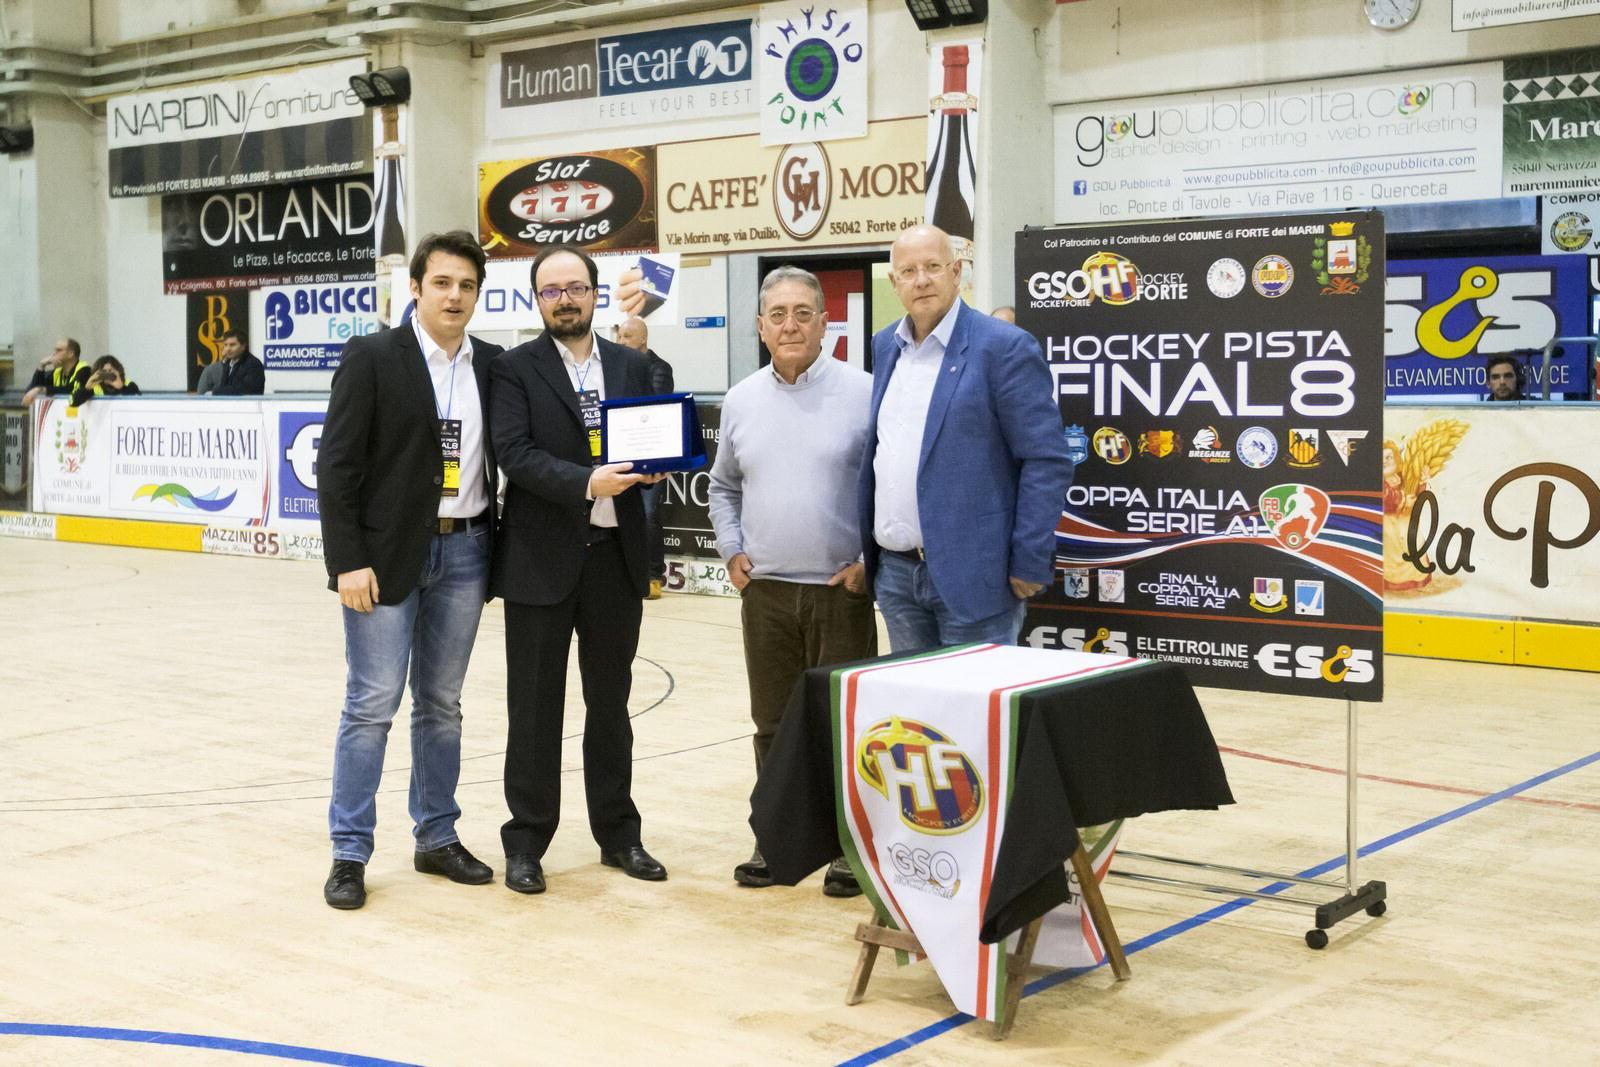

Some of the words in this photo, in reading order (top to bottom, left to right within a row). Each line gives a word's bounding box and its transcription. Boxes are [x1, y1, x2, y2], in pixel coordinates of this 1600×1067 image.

[764, 5, 863, 63] PHYSIO
[507, 63, 592, 100] Human
[601, 41, 683, 87] Tecar
[114, 90, 246, 139] NARDINI
[600, 102, 637, 118] FEEL
[650, 94, 695, 112] YOUR
[710, 88, 752, 107] BEST
[766, 92, 845, 131] POINT
[1162, 133, 1222, 155] design
[1241, 125, 1307, 152] printing
[1327, 121, 1372, 142] web
[1377, 114, 1478, 138] marketing
[535, 159, 591, 183] Slot
[1184, 167, 1318, 186] www.goupubblicita.com
[1327, 154, 1476, 176] info@goupubblicita.com
[165, 179, 188, 191] FORTE
[190, 177, 201, 189] DEI
[202, 175, 227, 188] MARMI
[667, 174, 767, 214] CAFFE'
[1092, 180, 1118, 192] GOU
[520, 198, 540, 215] 7
[550, 196, 569, 213] 7
[580, 193, 600, 210] 7
[1127, 198, 1168, 213] Ponte
[1171, 197, 1184, 212] di
[1188, 193, 1231, 211] Tavole
[1247, 190, 1271, 208] Via
[1275, 189, 1315, 206] Piave
[1321, 184, 1354, 203] 116
[1370, 182, 1449, 202] Querceta
[518, 218, 611, 245] Service
[684, 231, 711, 244] Morin
[713, 230, 731, 246] ang.
[733, 228, 747, 240] via
[829, 220, 861, 235] 55042
[866, 217, 897, 233] Forte
[1043, 238, 1058, 249] Col
[1059, 236, 1101, 248] Patrocinio
[1102, 238, 1108, 246] e
[1110, 235, 1116, 245] il
[1117, 232, 1161, 245] Contributo
[1162, 232, 1177, 242] del
[1178, 229, 1222, 241] COMUNE
[1224, 230, 1234, 240] di
[1235, 227, 1270, 238] FORTE
[1272, 226, 1287, 237] dei
[1289, 224, 1325, 236] MARMI
[233, 255, 244, 268] Le
[246, 253, 271, 268] Pizze,
[273, 251, 284, 265] Le
[286, 247, 334, 264] Focacce,
[337, 246, 349, 260] Le
[351, 245, 376, 259] Torte
[167, 281, 180, 293] Via
[229, 278, 246, 288] Forte
[248, 277, 258, 287] dei
[260, 275, 279, 286] Marmi
[282, 275, 292, 284] tel.
[294, 273, 313, 284] 0584
[1027, 269, 1093, 301] GSO
[1135, 272, 1185, 286] HOCKEY
[1030, 298, 1092, 309] HOCKEYFORTE
[1135, 283, 1189, 301] FORTE
[266, 347, 325, 359] CAMAIORE
[1046, 331, 1210, 362] HOCKEY
[1223, 329, 1352, 359] PISTA
[1384, 367, 1487, 388] LEVAMENTO
[116, 426, 165, 457] FORTE
[170, 431, 193, 458] DEI
[198, 428, 259, 461] MARMI
[1188, 450, 1232, 459] BREGANZE
[1156, 487, 1250, 512] ITALIA
[201, 528, 252, 544] MAZZINI
[1126, 511, 1216, 536] SERIE
[1223, 515, 1259, 538] A1
[1402, 489, 1476, 576] la
[1482, 461, 1600, 589] P
[253, 531, 280, 556] 85
[1137, 582, 1192, 597] COPPA
[1194, 585, 1241, 599] ITALIA
[1159, 572, 1204, 586] FINAL
[1205, 575, 1218, 587] 4
[1155, 594, 1200, 608] SERIE
[1202, 597, 1227, 610] A2
[1136, 636, 1249, 659] ELETTROLINE
[1136, 652, 1202, 666] SOLLEVAMENTO
[1203, 658, 1211, 666] &
[1211, 658, 1249, 669] SERVICE
[886, 842, 960, 890] GSO
